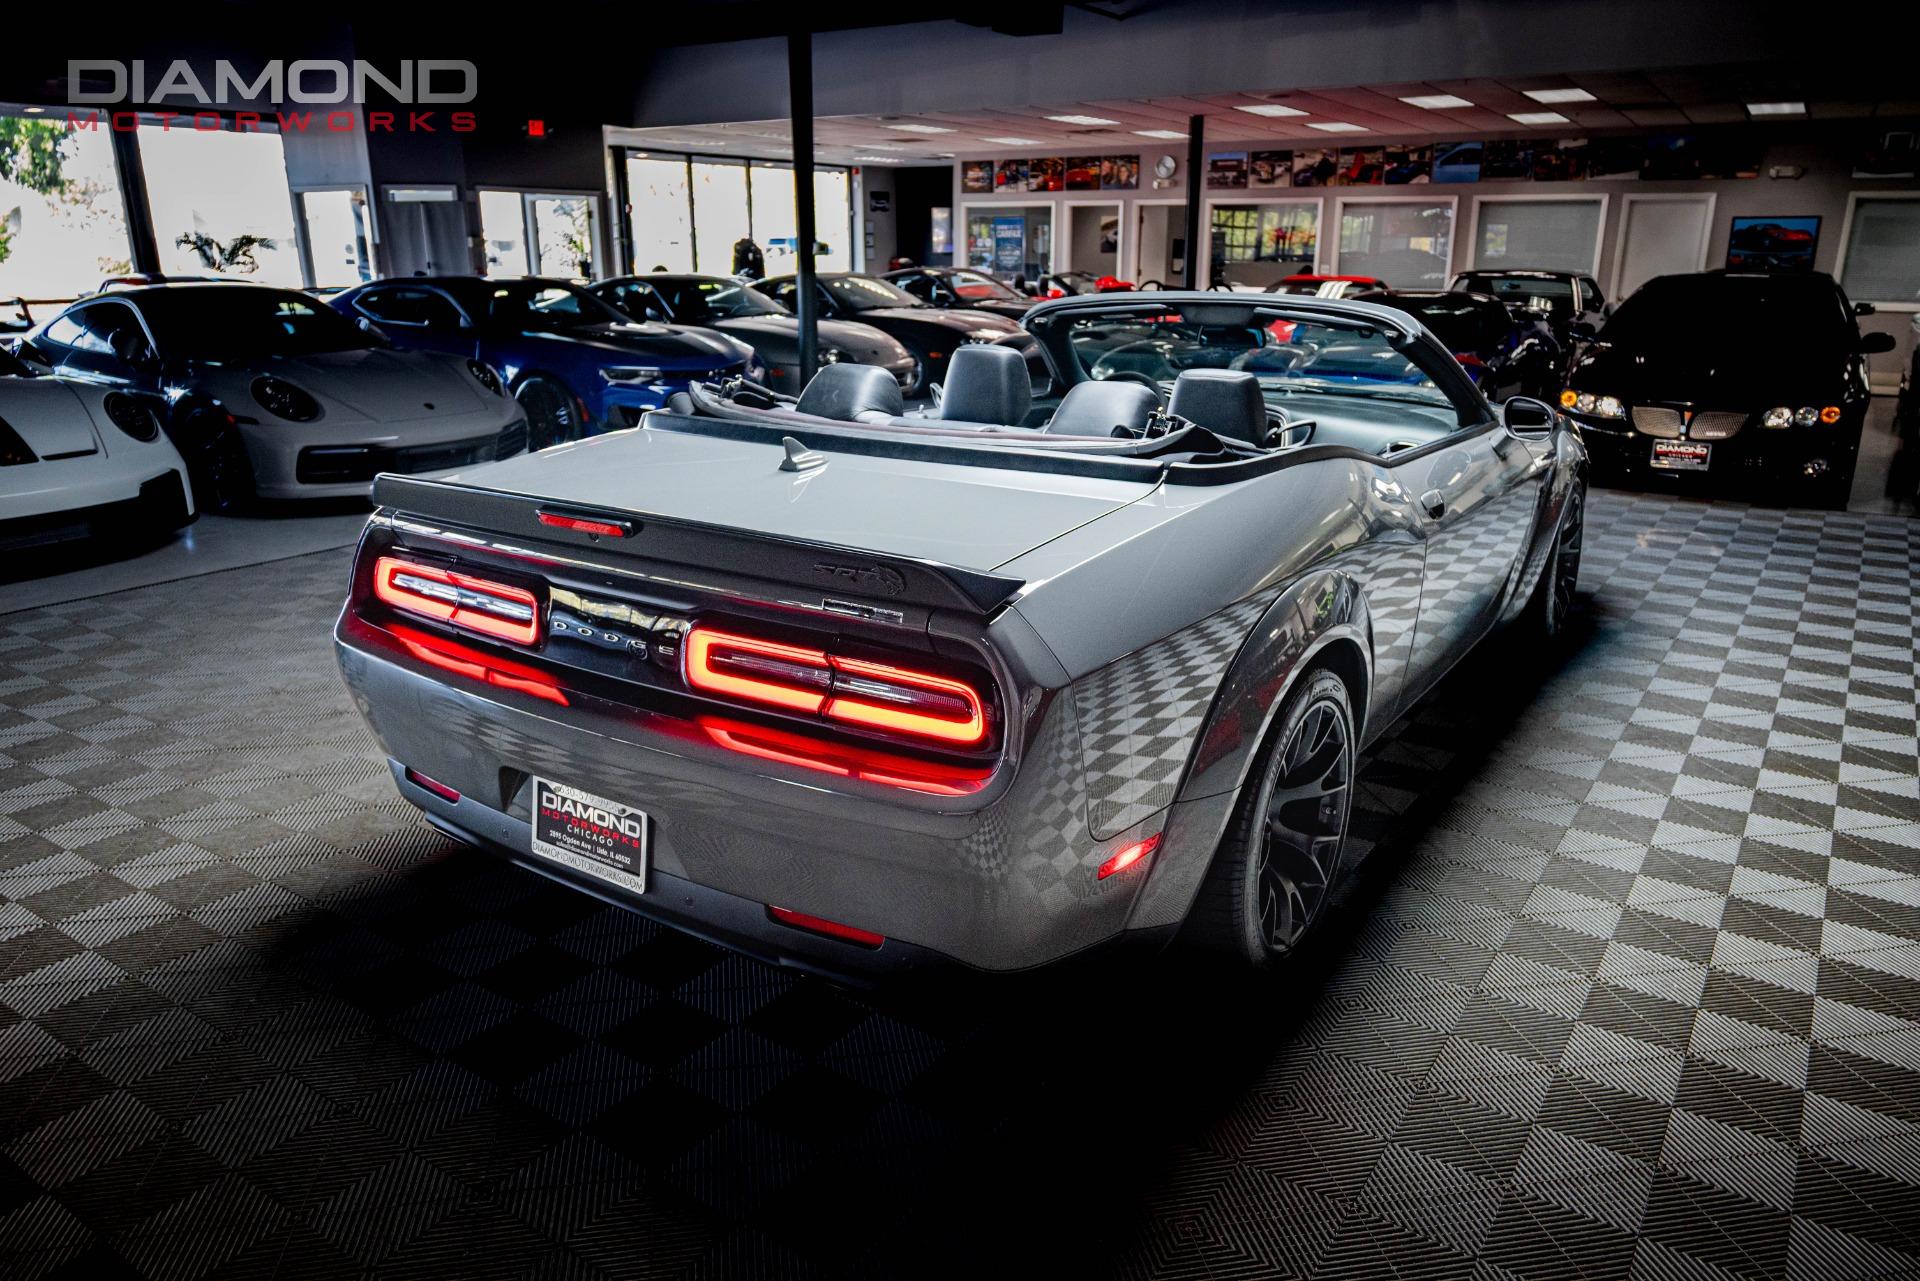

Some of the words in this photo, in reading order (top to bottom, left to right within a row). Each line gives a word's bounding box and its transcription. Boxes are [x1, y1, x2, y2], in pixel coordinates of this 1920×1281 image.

[1656, 444, 1707, 454] DIAMOND
[554, 621, 674, 656] DODGE
[541, 808, 640, 848] MOTORWORKS
[542, 791, 640, 838] DIAMOND
[562, 834, 581, 848] Ogden
[581, 840, 592, 851] Ave
[567, 825, 613, 847] CHICAGO
[533, 842, 643, 892] DIAMONDMOTORWORKS.COM
